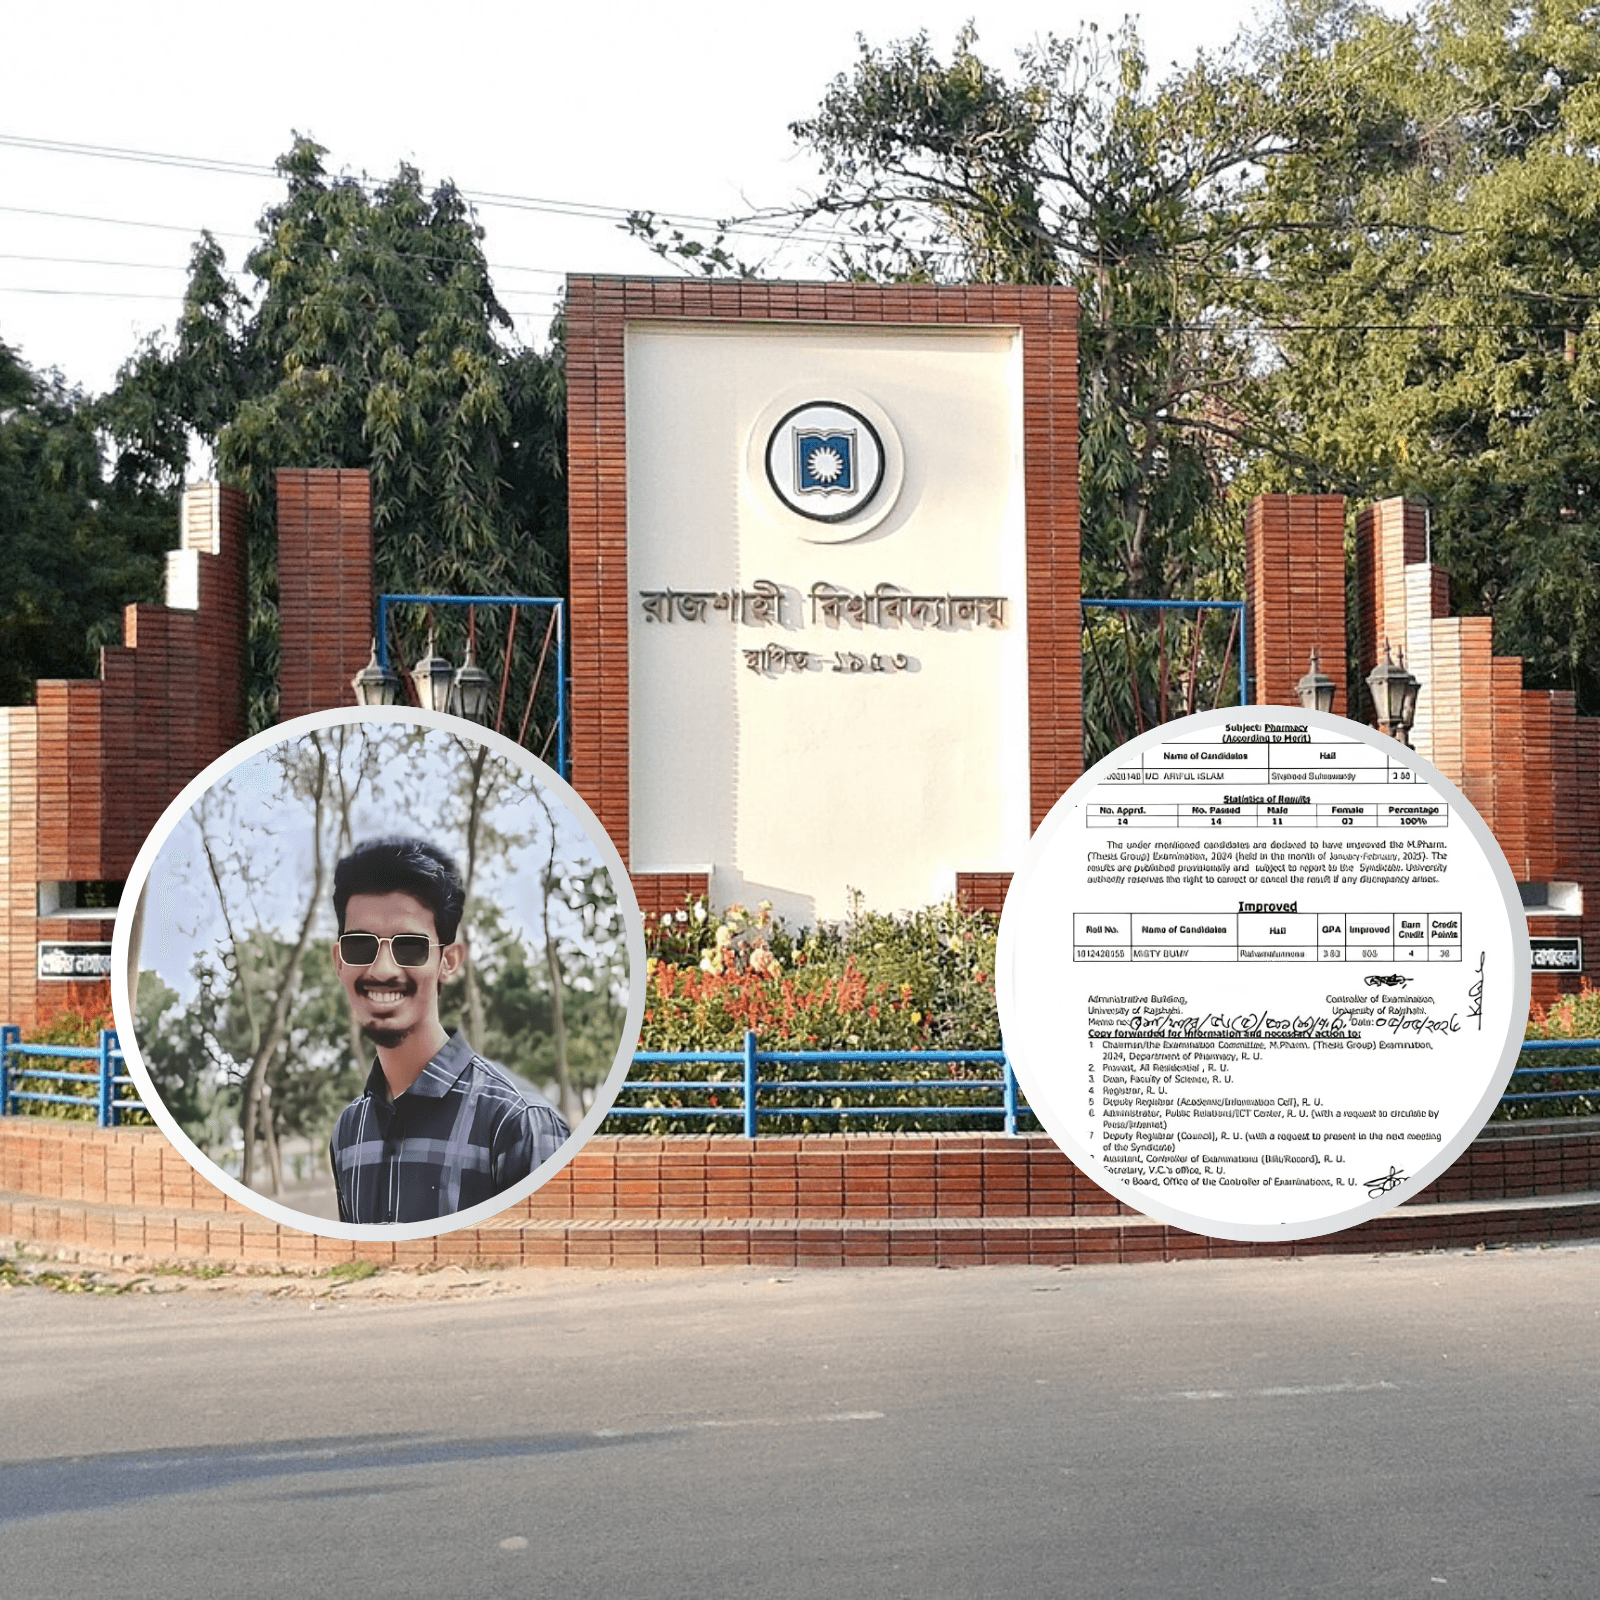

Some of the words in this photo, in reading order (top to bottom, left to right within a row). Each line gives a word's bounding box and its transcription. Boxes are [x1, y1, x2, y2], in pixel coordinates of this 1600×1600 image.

[639, 580, 784, 626] রাজশাহী
[808, 581, 1008, 628] বিশ্ববিদ্যালয়
[742, 643, 809, 675] স্থাপিত
[1238, 901, 1297, 912] Improved
[1349, 926, 1390, 935] Improved
